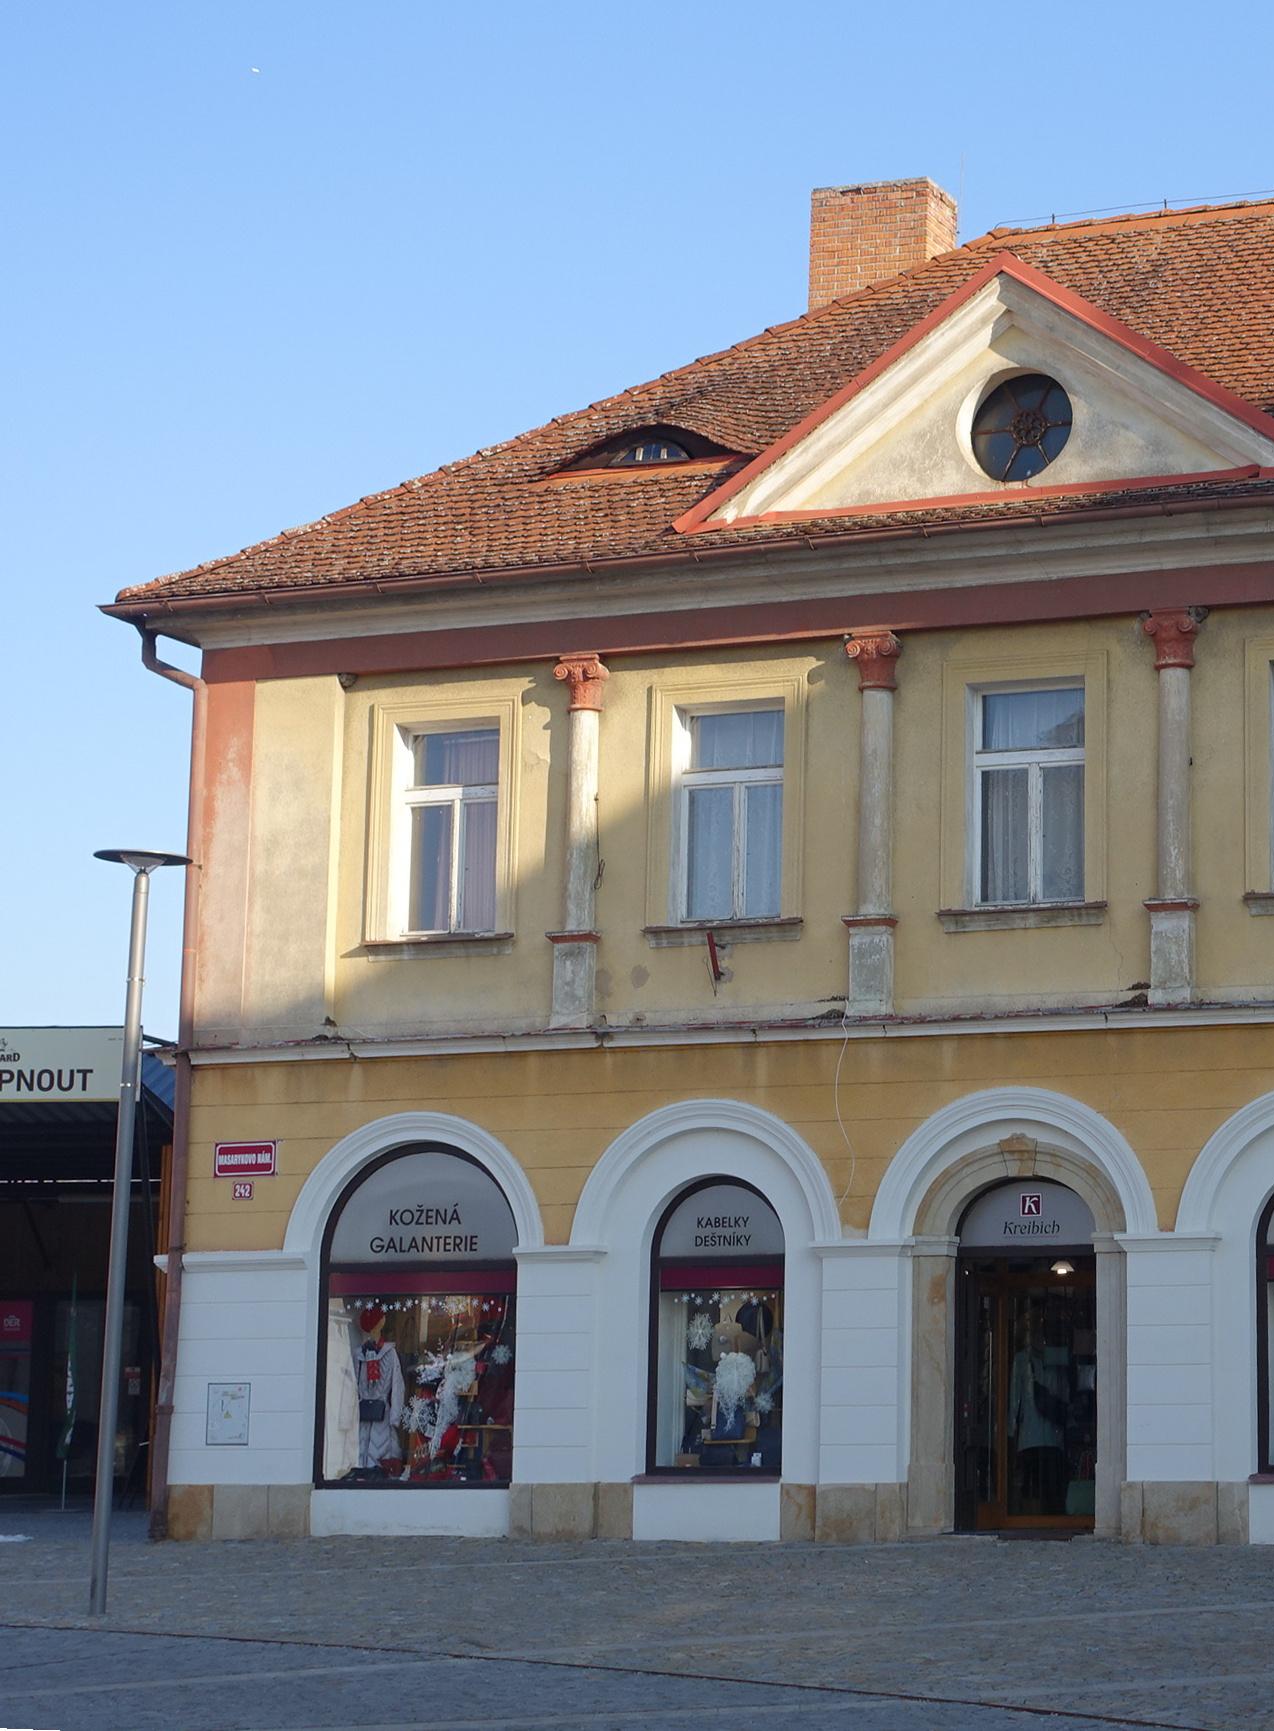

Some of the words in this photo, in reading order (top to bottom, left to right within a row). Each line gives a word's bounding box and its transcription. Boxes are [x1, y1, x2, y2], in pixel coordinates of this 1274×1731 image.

[0, 1068, 94, 1092] PNOUT
[218, 1153, 257, 1166] MASARYKOVO
[257, 1150, 272, 1164] NÁM.
[234, 1184, 251, 1197] 242
[1024, 1196, 1039, 1214] K
[389, 1202, 462, 1226] KOŽENÁ
[696, 1216, 750, 1229] KABELKY
[1003, 1219, 1061, 1236] Kreibich
[369, 1234, 479, 1254] GALANTERIE
[694, 1231, 751, 1248] DEŠTNÍKY
